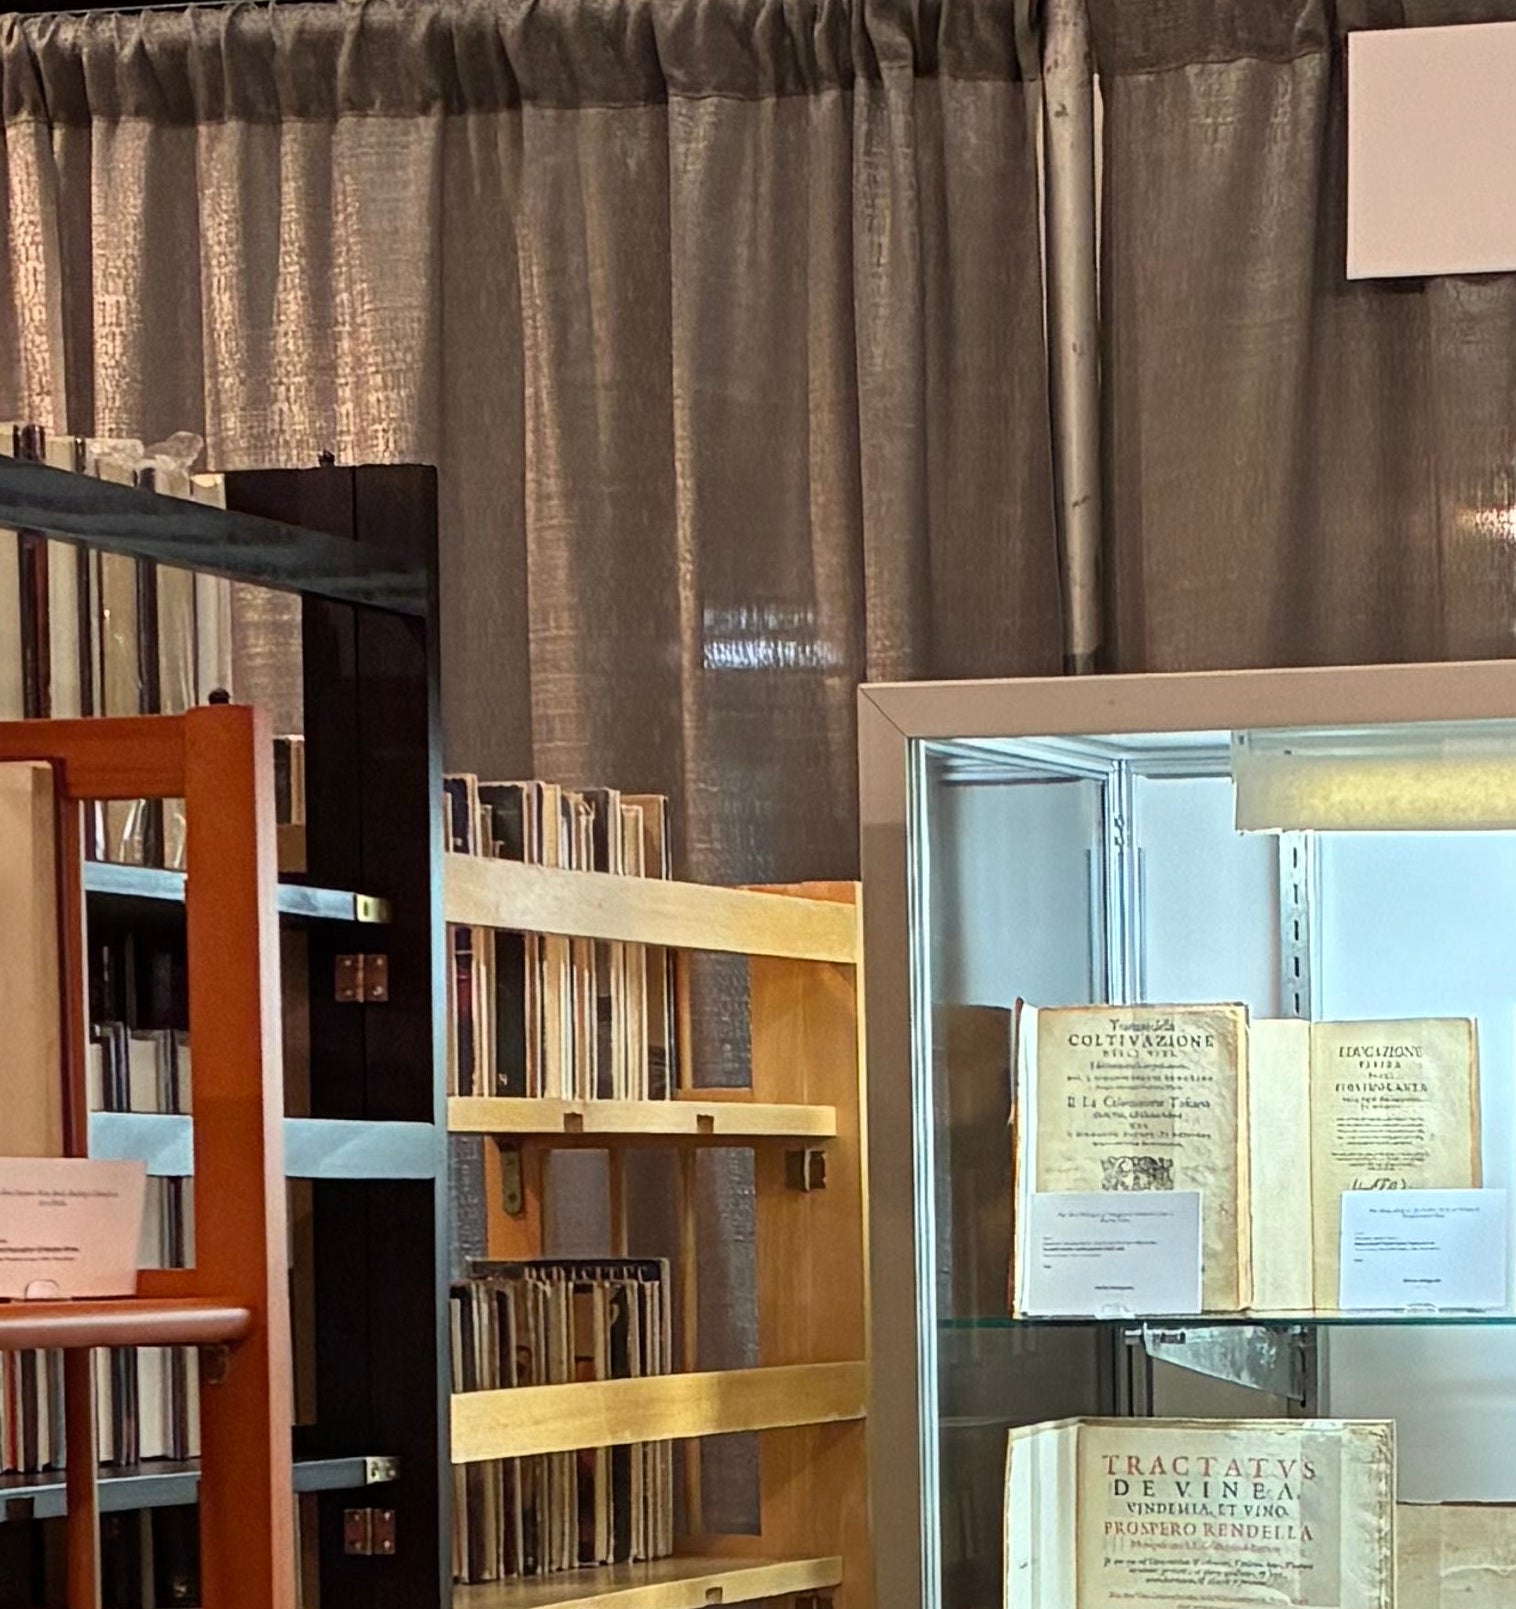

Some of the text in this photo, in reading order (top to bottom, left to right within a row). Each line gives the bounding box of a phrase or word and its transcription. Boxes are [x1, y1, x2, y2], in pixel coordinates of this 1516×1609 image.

[1068, 1034, 1214, 1048] COLTIVAZIONE
[1102, 1455, 1316, 1481] TRACTATVS
[1114, 1479, 1155, 1497] DE
[1104, 1521, 1314, 1542] PROSPERO RENDELLA
